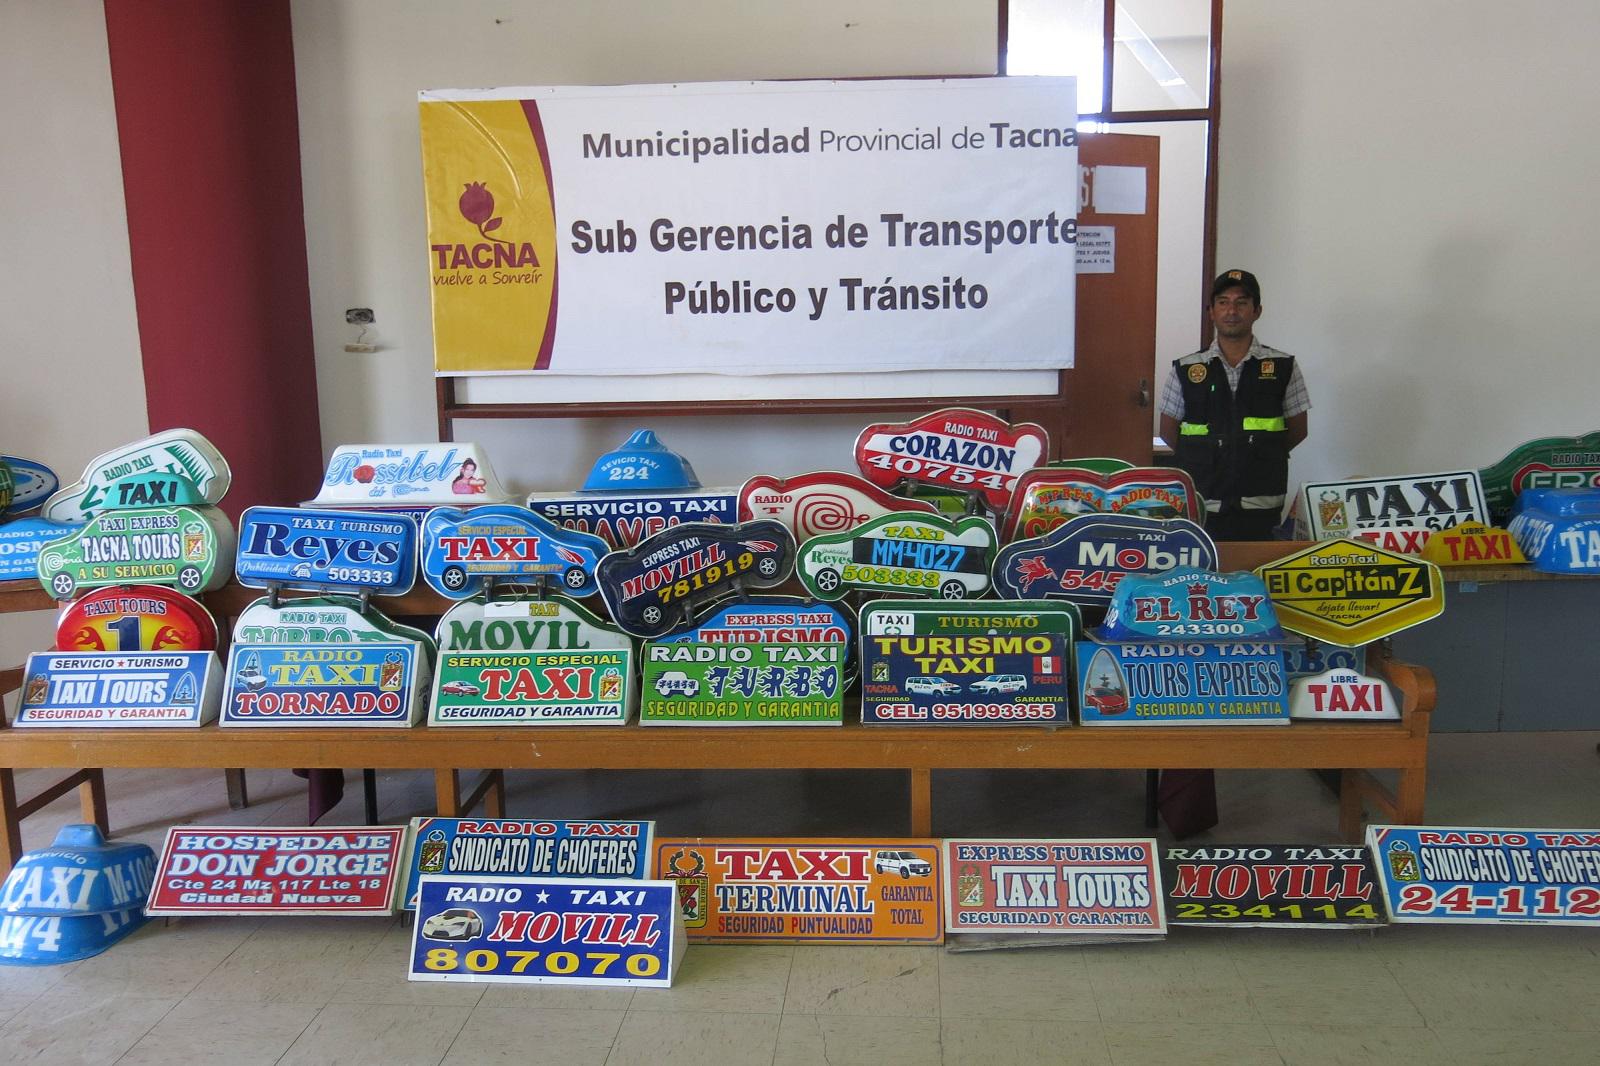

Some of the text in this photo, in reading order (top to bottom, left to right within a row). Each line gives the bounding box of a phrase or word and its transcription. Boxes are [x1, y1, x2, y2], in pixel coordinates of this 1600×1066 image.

[582, 121, 1078, 163] Municipalidad Provincial de Tacna
[571, 210, 1077, 255] Sub Gerencia de Transporte
[432, 242, 540, 270] TACNA
[433, 270, 542, 285] vuelve a Sonreír
[665, 277, 988, 320] Público y Tránsito
[944, 422, 999, 442] RADIO TAXI
[362, 448, 402, 458] Radio Taxi
[889, 435, 1017, 473] CORAZON
[103, 455, 154, 481] RADIO TAXI
[601, 457, 661, 472] SEVICIO TAXI
[609, 466, 649, 481] 224
[119, 481, 178, 505] TAXI
[1110, 488, 1185, 513] RADIO TAXI
[1345, 478, 1473, 521] TAXI
[544, 499, 727, 517] SERVICIO TAXI
[100, 516, 179, 531] TAXI EXPRESS
[292, 518, 403, 535] TAXI TURISMO
[1460, 527, 1486, 535] LIBRE
[883, 526, 945, 541] TAXI
[1137, 533, 1166, 542] TAXI
[81, 533, 180, 563] TACNA TOURS
[243, 522, 400, 569] Reyes
[439, 536, 540, 562] TAXI
[642, 537, 700, 568] EXPRESS TAXI
[1443, 533, 1512, 562] TAXI
[811, 550, 853, 567] Reyes
[1078, 541, 1200, 569] Mobil
[1311, 553, 1378, 565] Radio Taxi
[78, 564, 176, 579] A SU SERVICIO
[328, 567, 393, 584] 503333
[621, 542, 726, 602] MOVILL
[658, 552, 753, 604] 781919
[842, 565, 940, 588] 503333
[1163, 574, 1229, 587] RADIO TAXI
[1268, 568, 1423, 597] El Capitán Z
[84, 598, 167, 616] TAXI TOURS
[529, 603, 560, 617] TAXI
[1134, 597, 1180, 622] EL
[1188, 595, 1264, 621] REY
[279, 612, 347, 624] RADIO TAXI
[726, 613, 833, 626] EXPRESS TAXI
[877, 615, 910, 625] TAXI
[938, 616, 1039, 628] TURISMO
[449, 620, 590, 650] MOVIL
[1157, 624, 1244, 635] 243300
[650, 646, 838, 662] RADIO TAXI
[873, 637, 1052, 655] TURISMO
[55, 658, 183, 669] SERVICIO TURISMO
[282, 650, 363, 662] RADIO
[447, 655, 622, 667] SERVICIO ESPECIAL
[914, 657, 995, 674] TAXI
[269, 664, 380, 687] TAXI
[479, 667, 596, 701] TAXI
[703, 665, 839, 699] TURBO
[1124, 661, 1282, 699] TOURS EXPRESS
[50, 672, 170, 705] TAXI TOURS
[1308, 684, 1383, 711] TAXI
[236, 691, 401, 716] TORNADO
[442, 706, 618, 718] SEGURIDAD Y GARANTIA
[647, 700, 840, 718] SEGURIDAD Y GARANTIA
[875, 703, 1056, 719] CEL: 951993355
[1135, 702, 1282, 716] SEGURIDAD Y GARANTIA
[28, 708, 187, 719] SEGURIDAD Y GARANTIA
[458, 821, 640, 837] RADIO TAXI
[177, 835, 391, 851] HOSPEDAJE
[448, 836, 638, 875] SINDICATO DE CHOFERES
[958, 845, 1145, 861] EXPRESS TURISMO
[1165, 848, 1365, 861] RADIO TAXI
[167, 853, 390, 876] DON JORGE
[715, 848, 871, 882] TAXI
[168, 879, 381, 890] Cte 24 Mz 117 Lte 18
[991, 865, 1150, 909] TAXI TOURS
[1170, 864, 1373, 901] MOVILL
[179, 892, 361, 904] Ciudad Nueva
[445, 887, 646, 906] RADIO TAXI
[715, 884, 875, 915] TERMINAL
[881, 885, 933, 902] GARANTIA
[891, 909, 924, 925] TOTAL
[959, 912, 1153, 925] SEGURIDAD Y GARANTIA
[1175, 903, 1378, 920] 234114
[487, 910, 659, 947] MOVILL
[718, 916, 873, 934] SEGURIDAD PUNTUALIDAD
[424, 948, 661, 976] 807070
